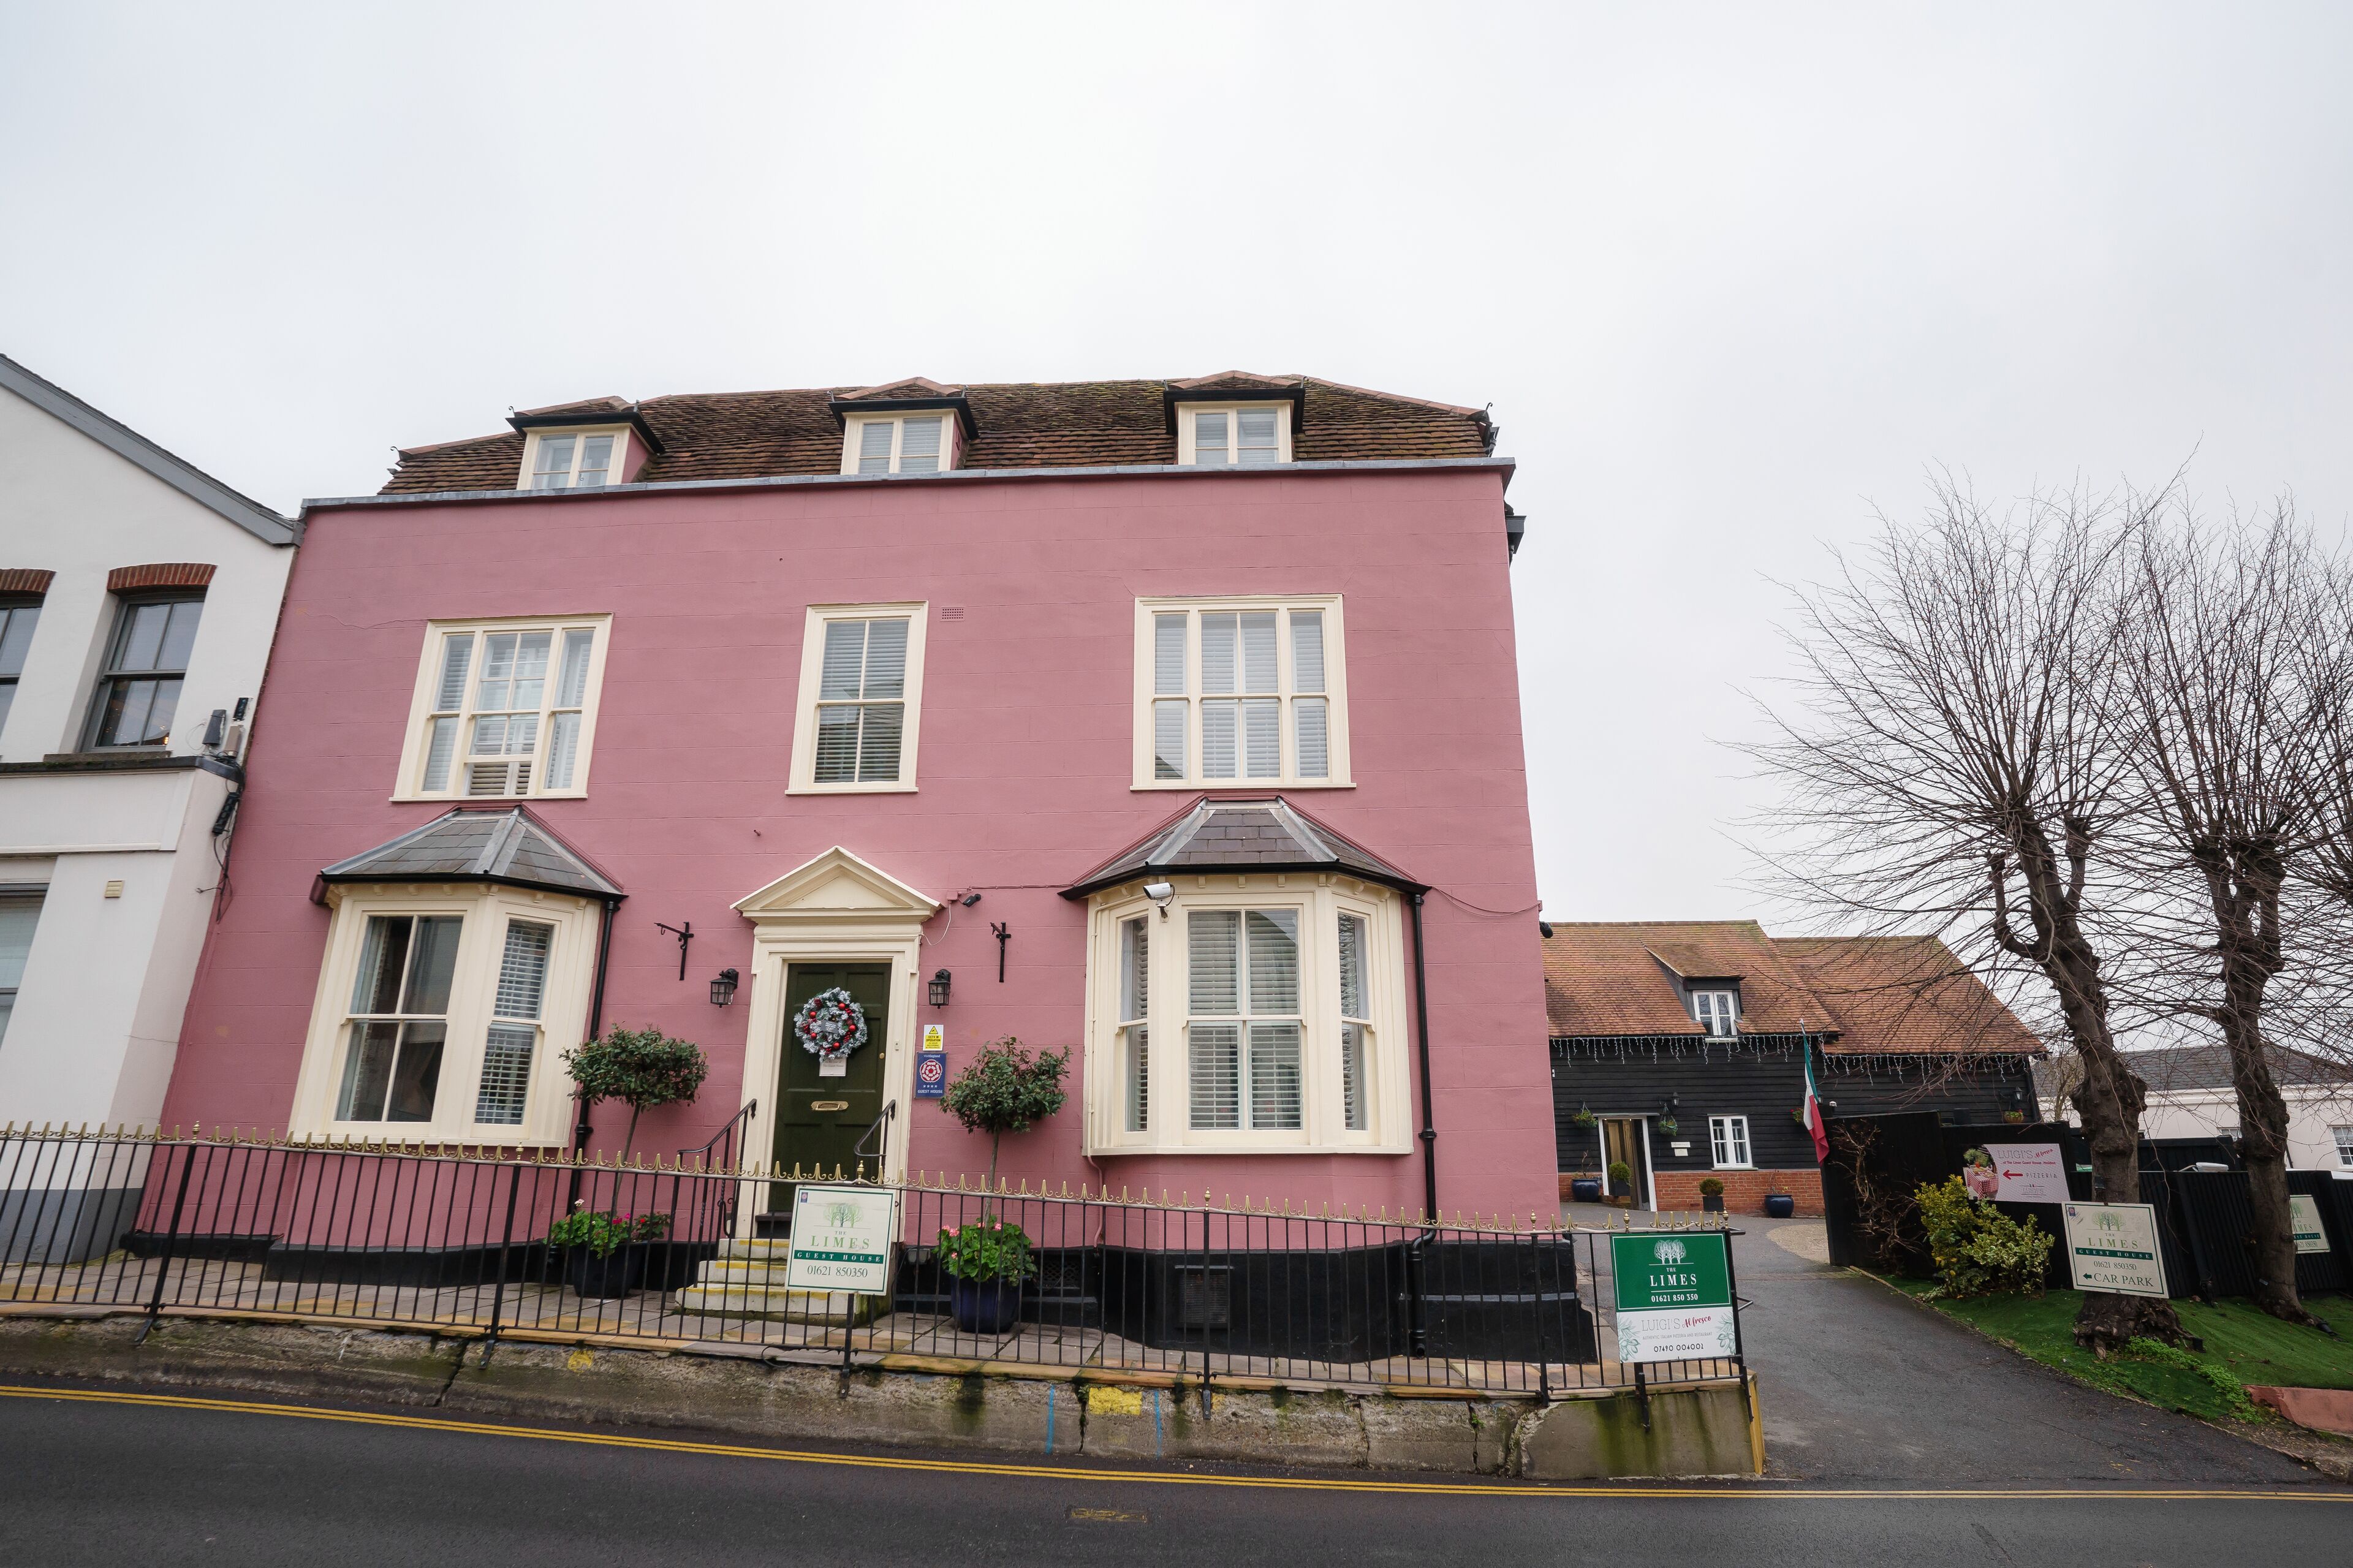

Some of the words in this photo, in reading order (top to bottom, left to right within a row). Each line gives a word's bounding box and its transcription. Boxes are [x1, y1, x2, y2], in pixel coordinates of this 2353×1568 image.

[1998, 1150, 2033, 1159] LUIGI'S
[811, 1235, 870, 1249] LIMES
[2088, 1237, 2138, 1249] LIMES
[807, 1265, 831, 1276] 01621
[836, 1267, 868, 1278] 850350
[1650, 1273, 1697, 1287] LIMES
[2094, 1273, 2119, 1284] CAR
[2122, 1275, 2154, 1287] PARK
[1642, 1318, 1681, 1331] LUIGI'S
